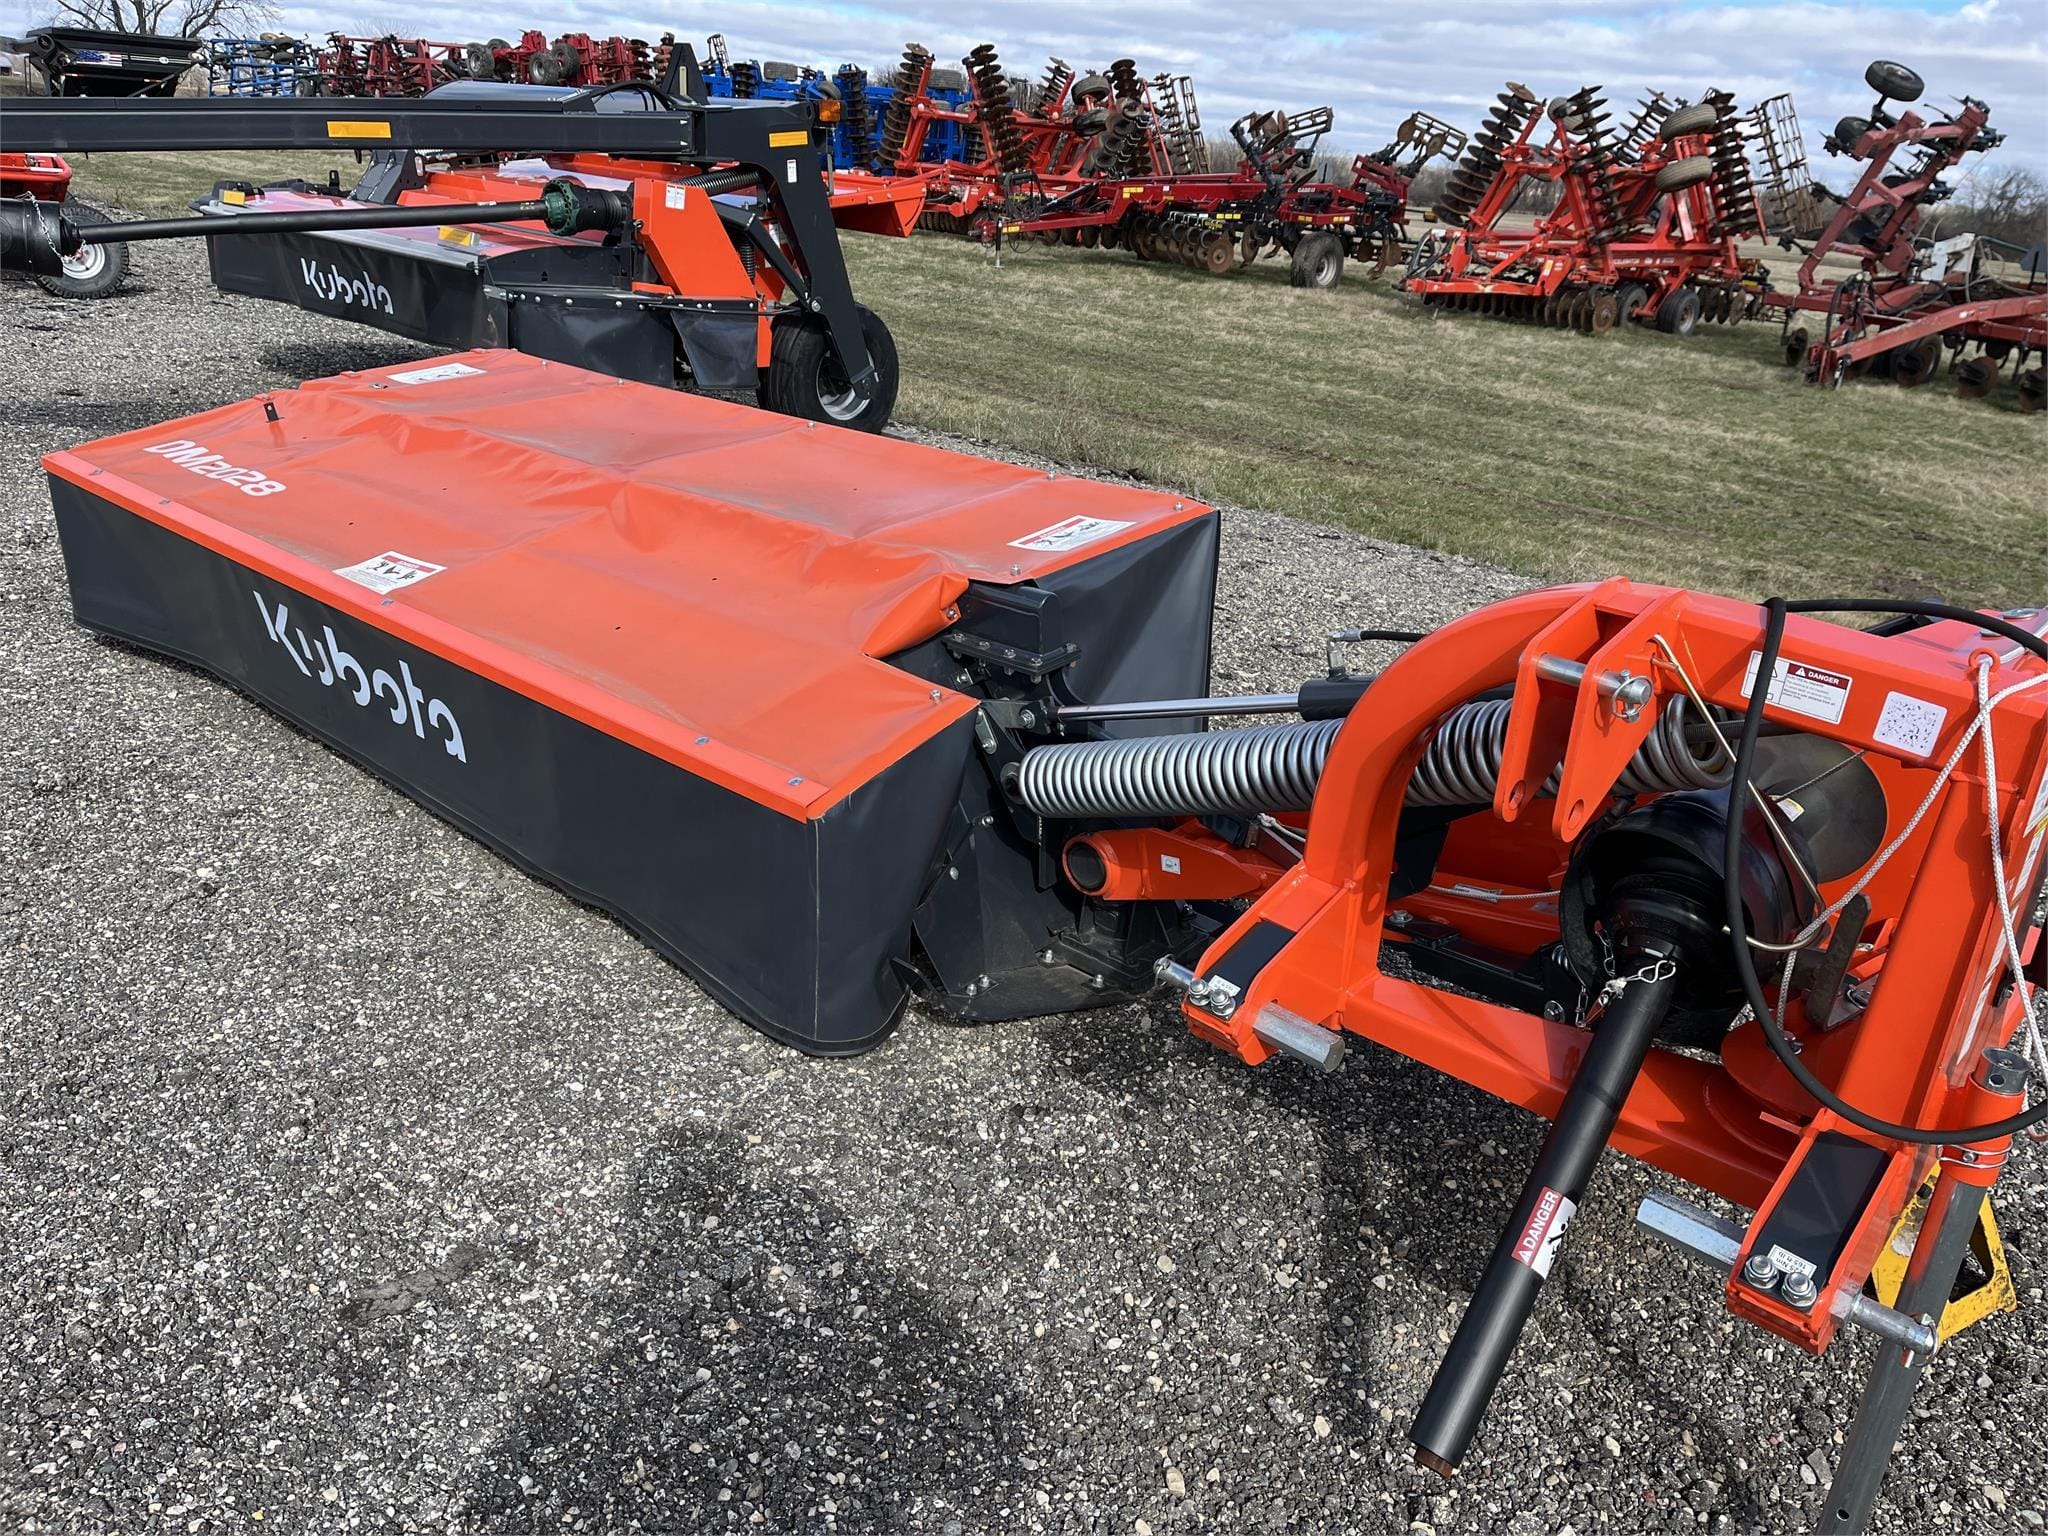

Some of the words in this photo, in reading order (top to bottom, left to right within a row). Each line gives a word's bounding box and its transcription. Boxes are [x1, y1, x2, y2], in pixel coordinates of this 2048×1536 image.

[300, 257, 394, 315] Kubota
[143, 439, 288, 497] DM2028
[253, 590, 467, 764] Kubota
[1808, 671, 1840, 685] DANGER
[1522, 1191, 1559, 1250] DANGER
